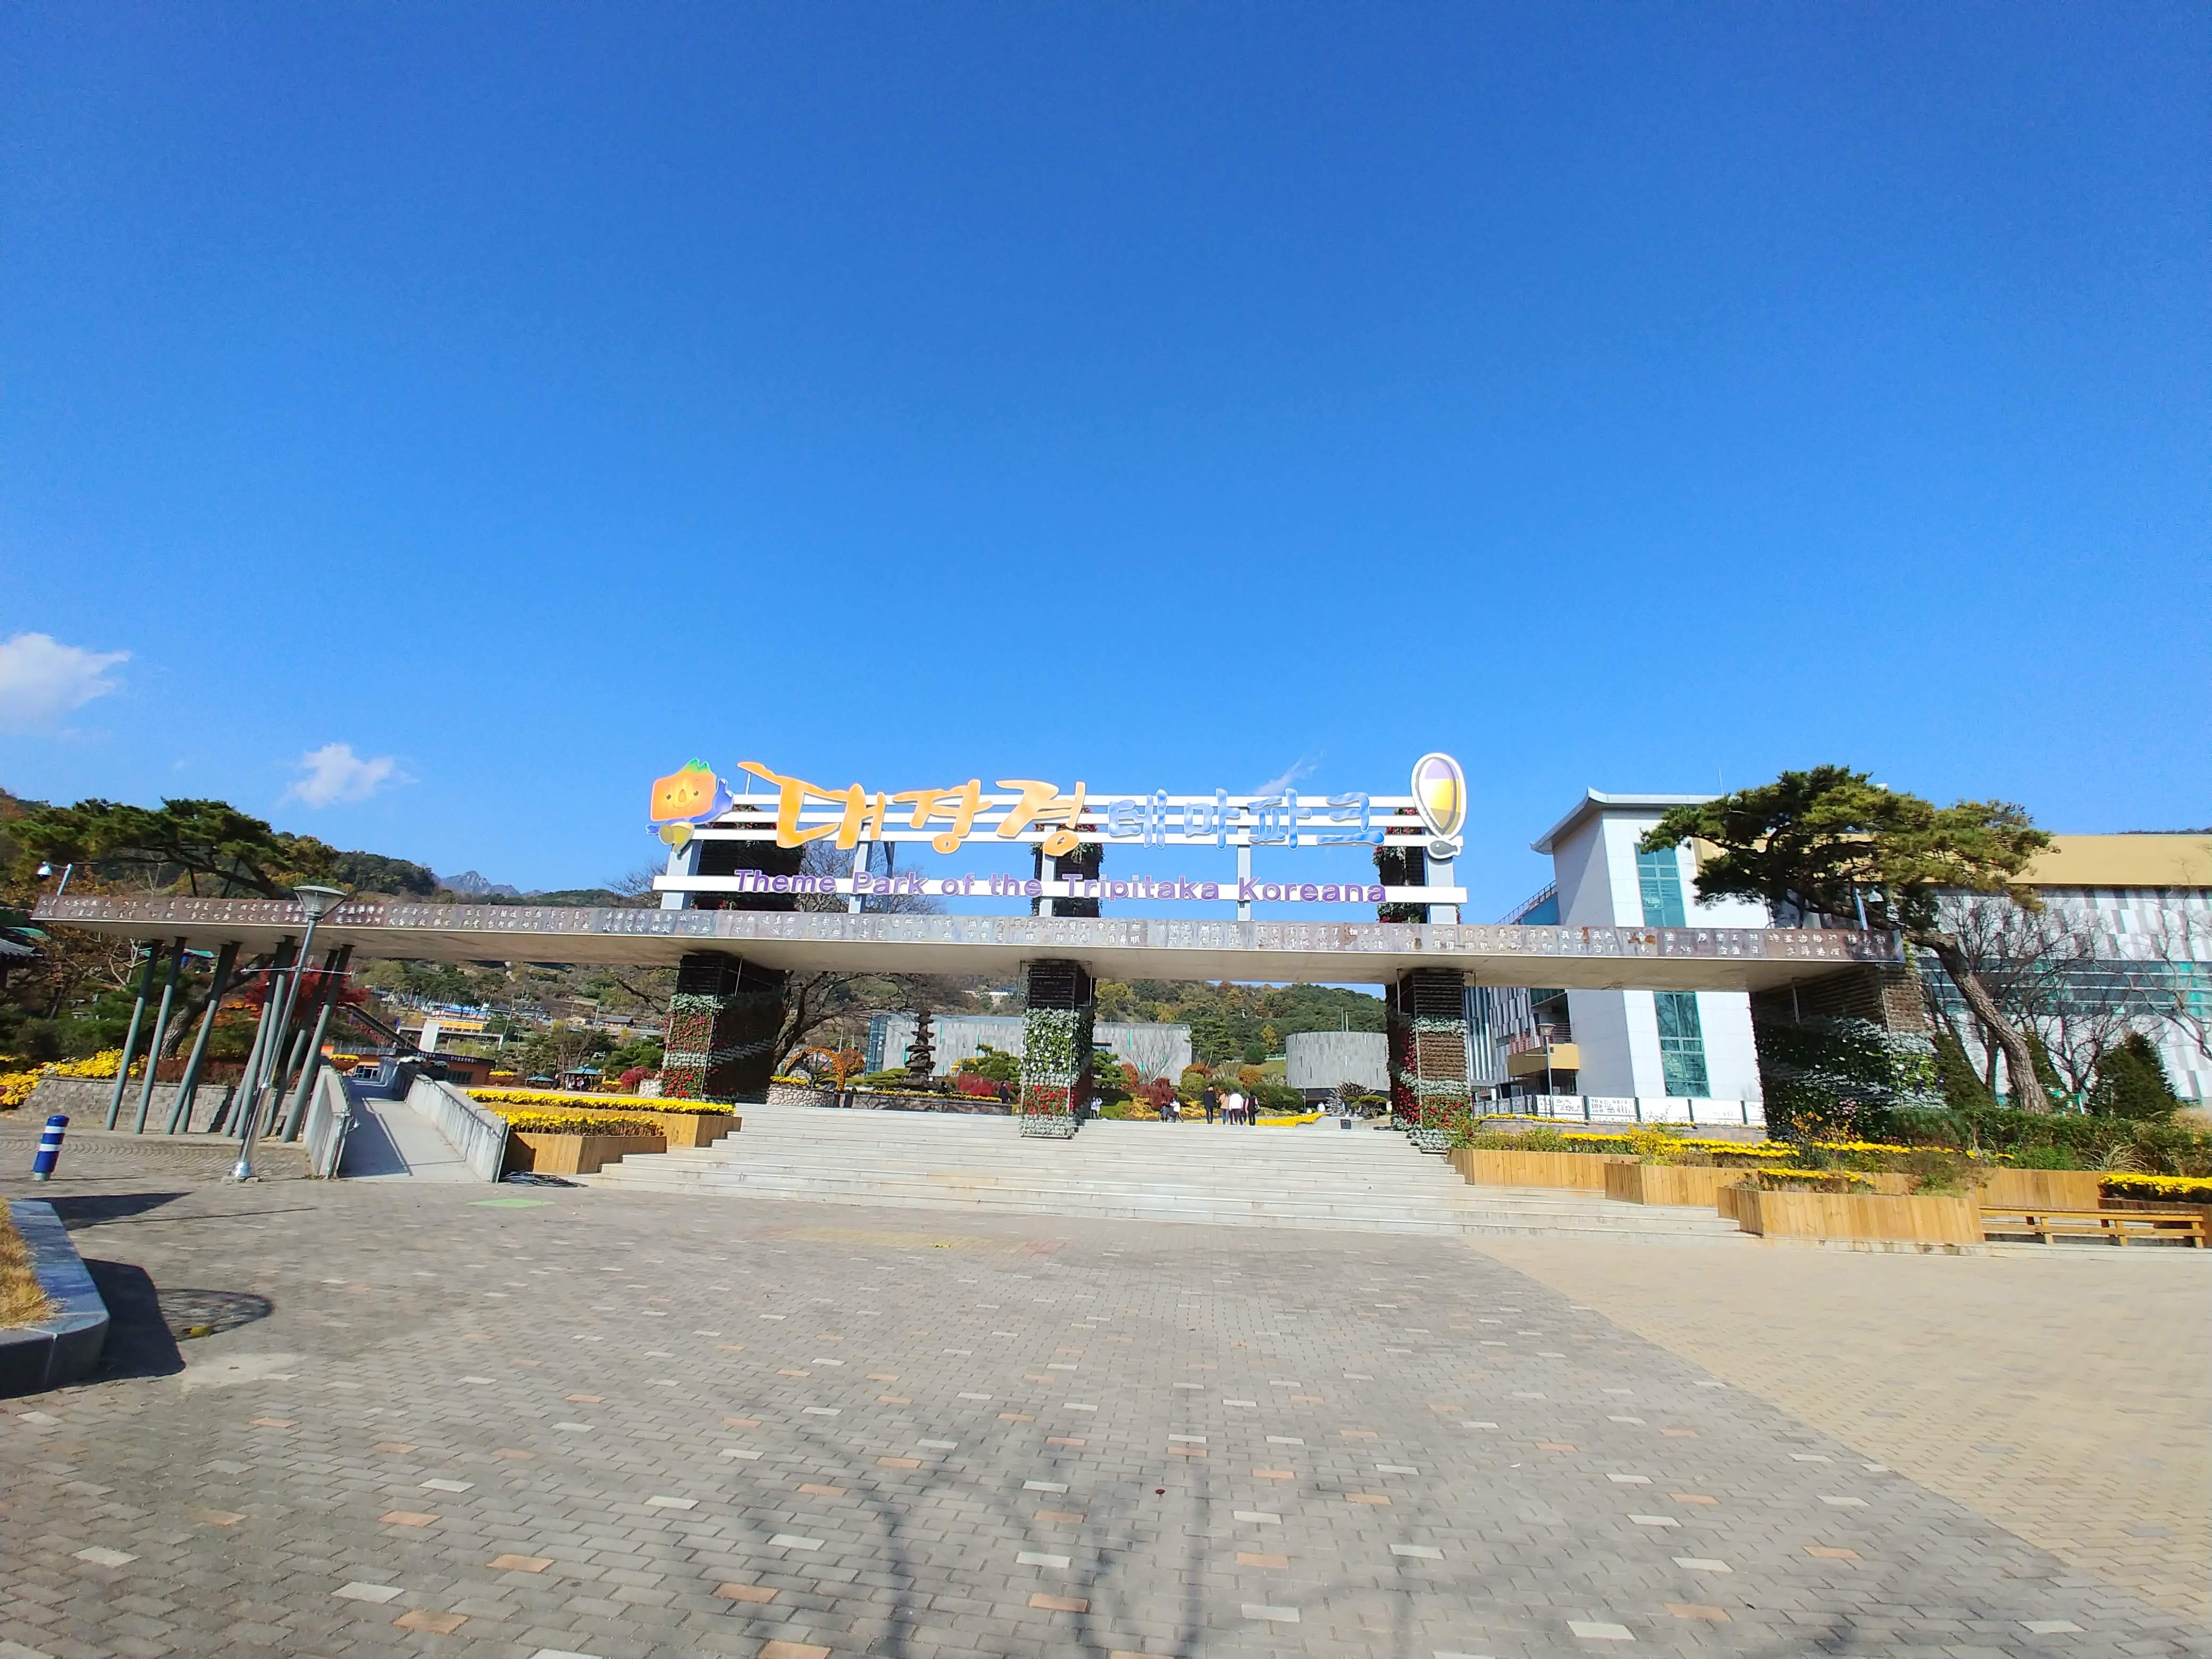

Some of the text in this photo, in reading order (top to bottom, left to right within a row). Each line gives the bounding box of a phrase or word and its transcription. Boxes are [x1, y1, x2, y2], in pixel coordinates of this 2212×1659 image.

[737, 761, 1385, 857] 대장경 테마파크
[734, 869, 1387, 904] Theme Park of the Tripitaka Koreana
